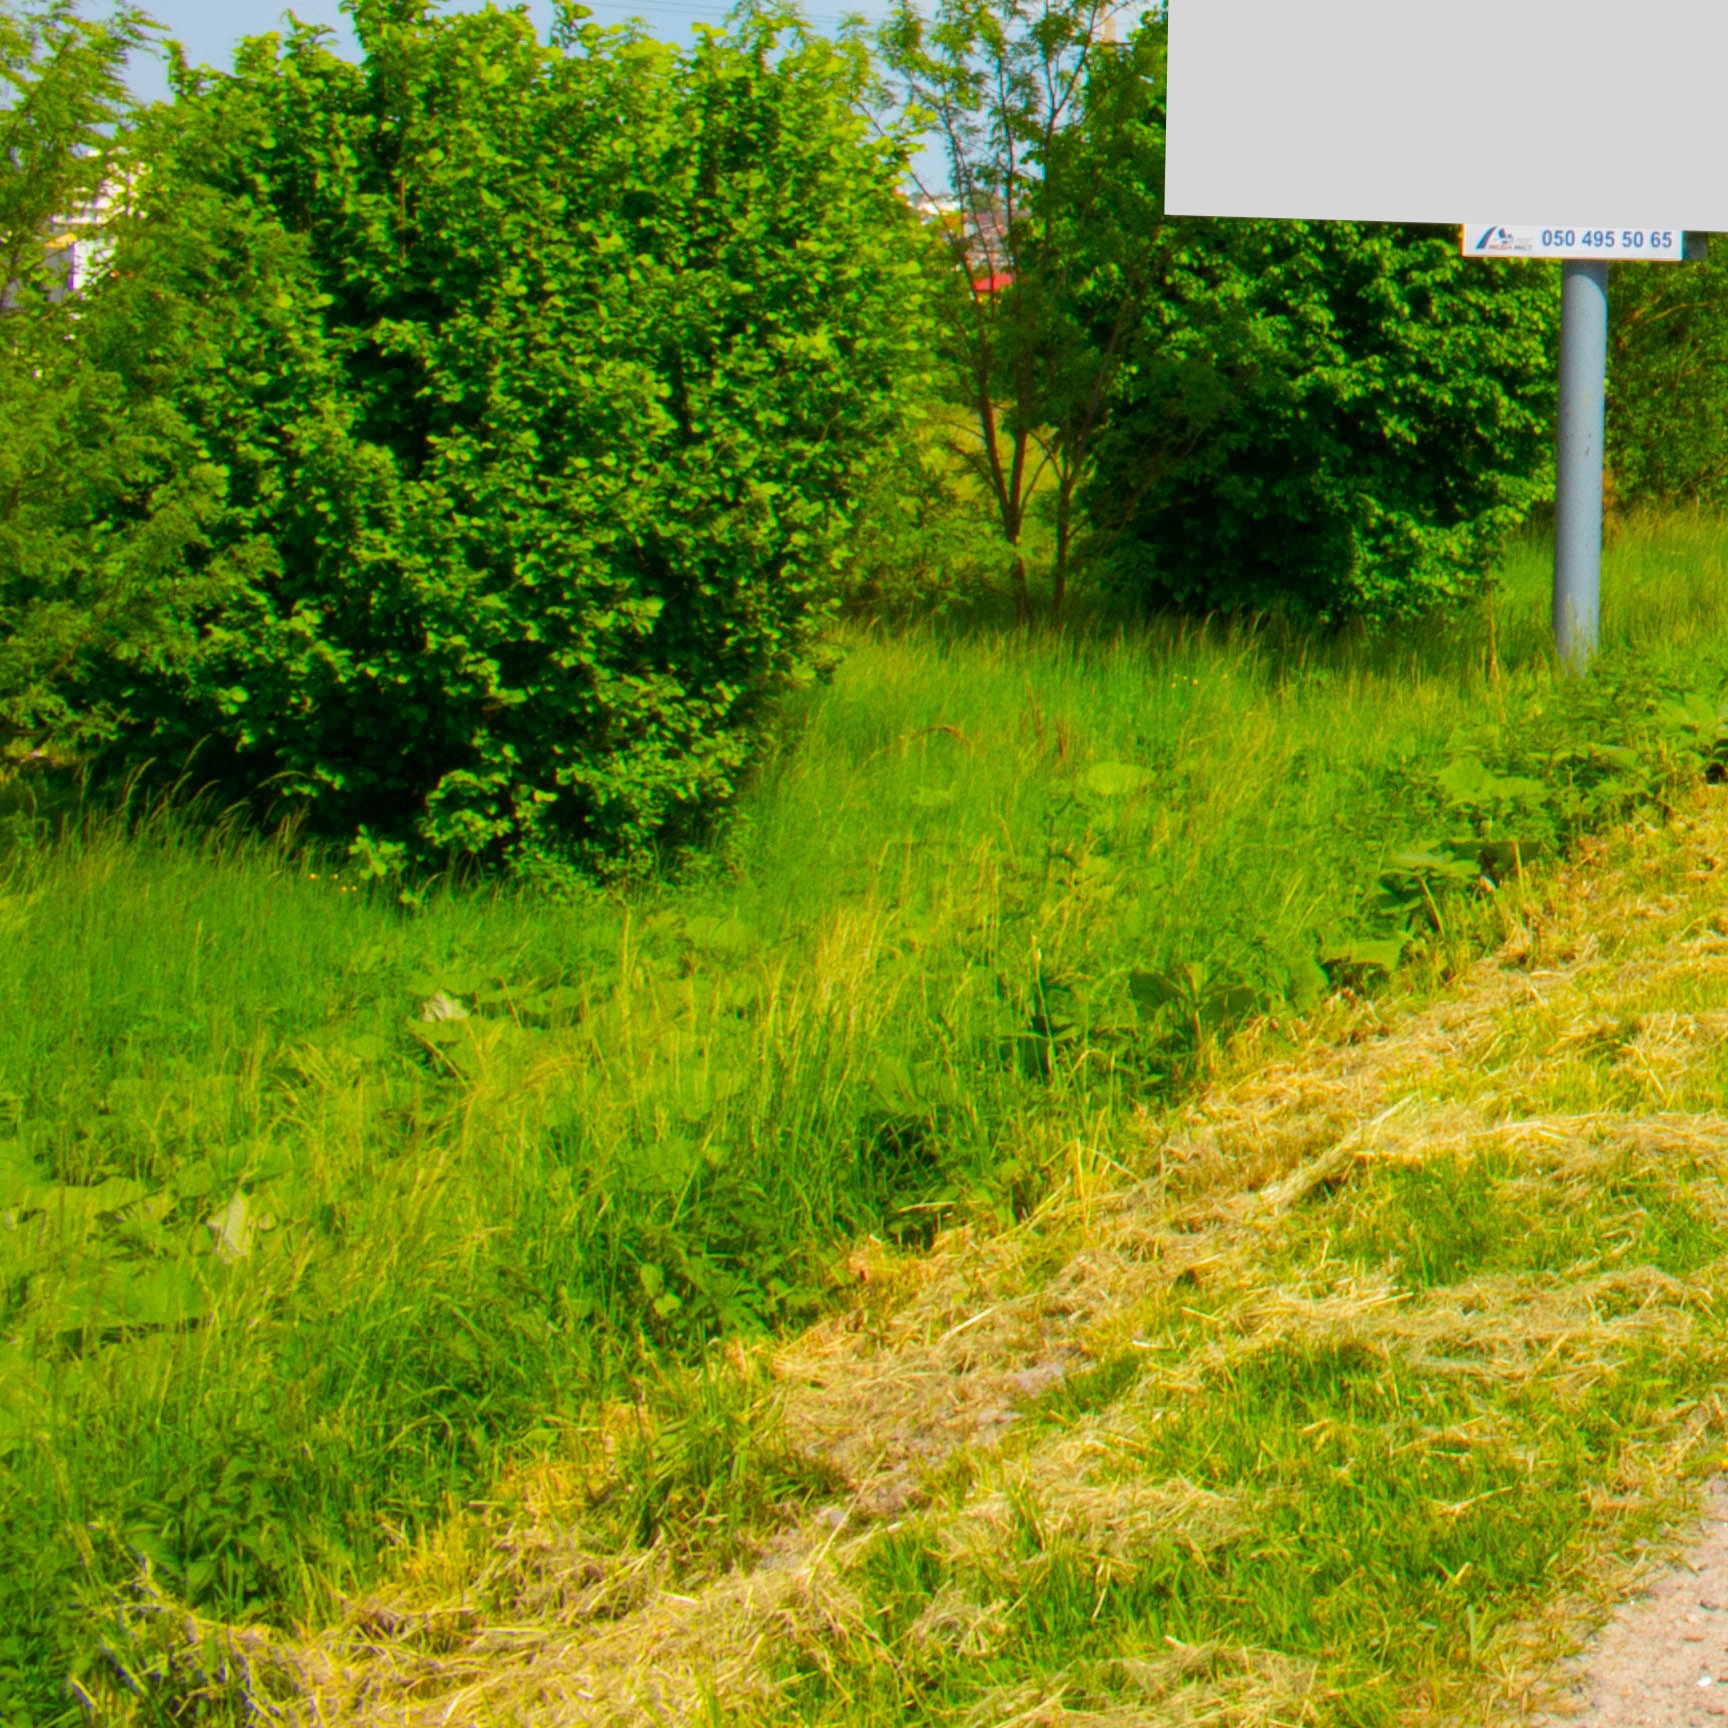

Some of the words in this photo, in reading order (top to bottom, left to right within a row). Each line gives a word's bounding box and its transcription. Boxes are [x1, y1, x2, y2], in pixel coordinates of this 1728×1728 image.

[1542, 229, 1575, 247] 050
[1581, 230, 1615, 248] 495
[1622, 231, 1644, 248] 50
[1650, 231, 1673, 249] 65
